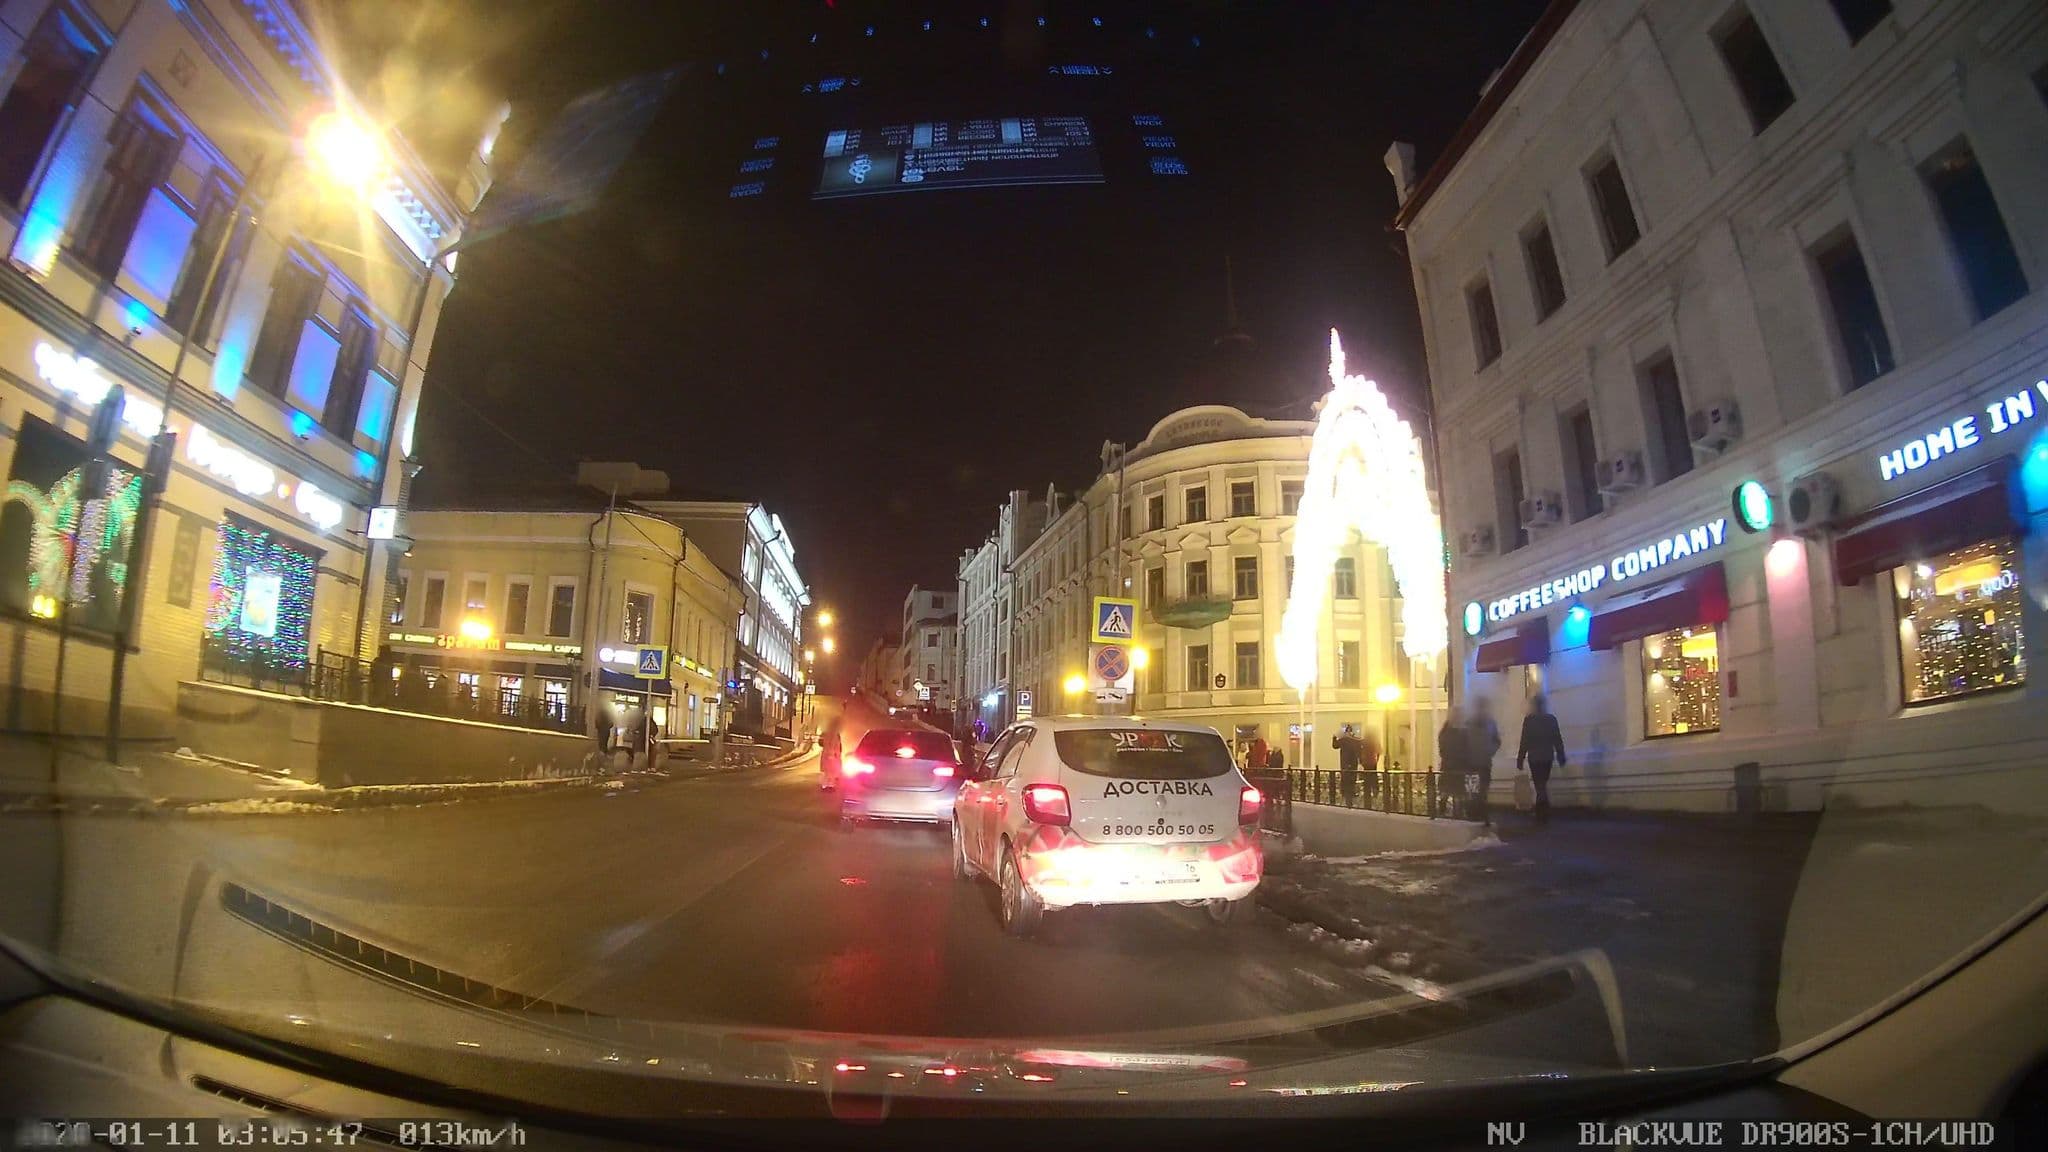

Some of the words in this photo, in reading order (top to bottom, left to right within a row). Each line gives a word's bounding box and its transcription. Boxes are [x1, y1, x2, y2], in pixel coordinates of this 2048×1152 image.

[1879, 415, 1981, 481] HOME
[1986, 389, 2036, 434] IN
[1489, 564, 1608, 621] COFFEESHOP
[1611, 518, 1728, 581] COMPANY
[1103, 781, 1213, 799] ДОСТАВКА
[1103, 825, 1111, 836] 8
[1115, 825, 1143, 836] 800
[1147, 825, 1174, 836] 500
[1178, 825, 1194, 835] 50
[1199, 824, 1214, 835] 05
